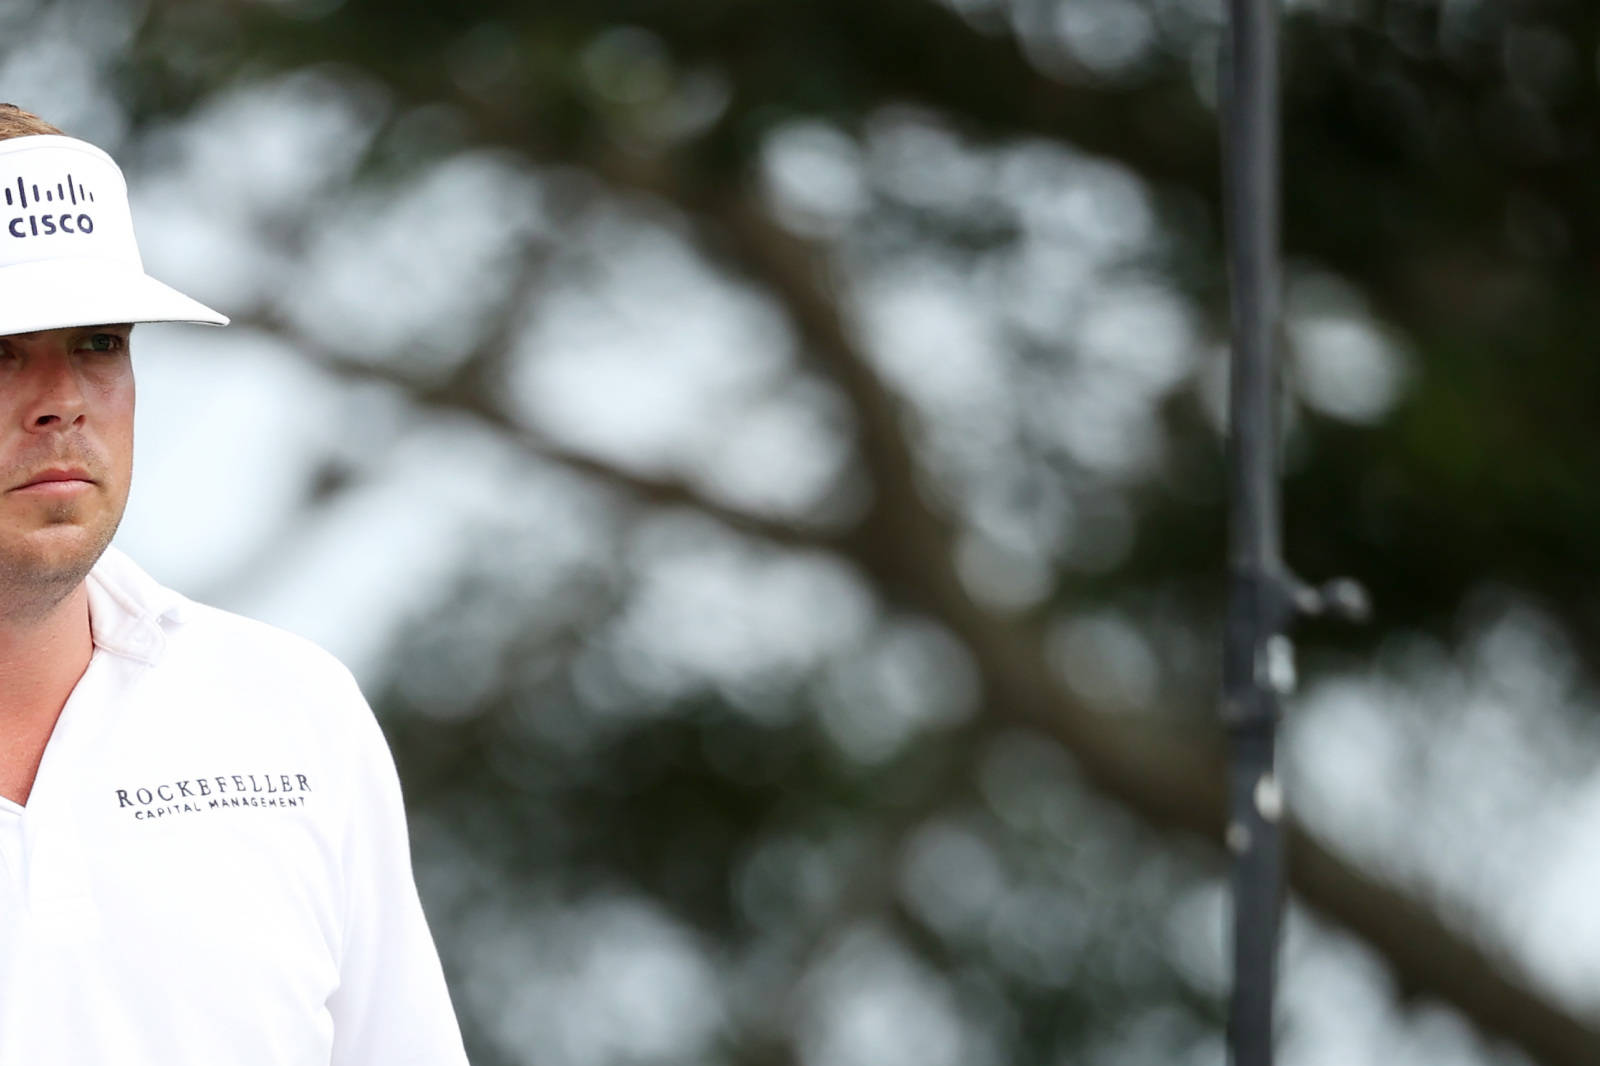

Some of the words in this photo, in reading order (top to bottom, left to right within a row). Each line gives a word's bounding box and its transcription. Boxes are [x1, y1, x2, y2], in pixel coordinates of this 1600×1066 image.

[8, 213, 94, 238] CISCO
[115, 773, 312, 808] ROCKEFELLER
[135, 804, 202, 820] CAPITAL
[209, 796, 305, 809] MANAGEMENT
